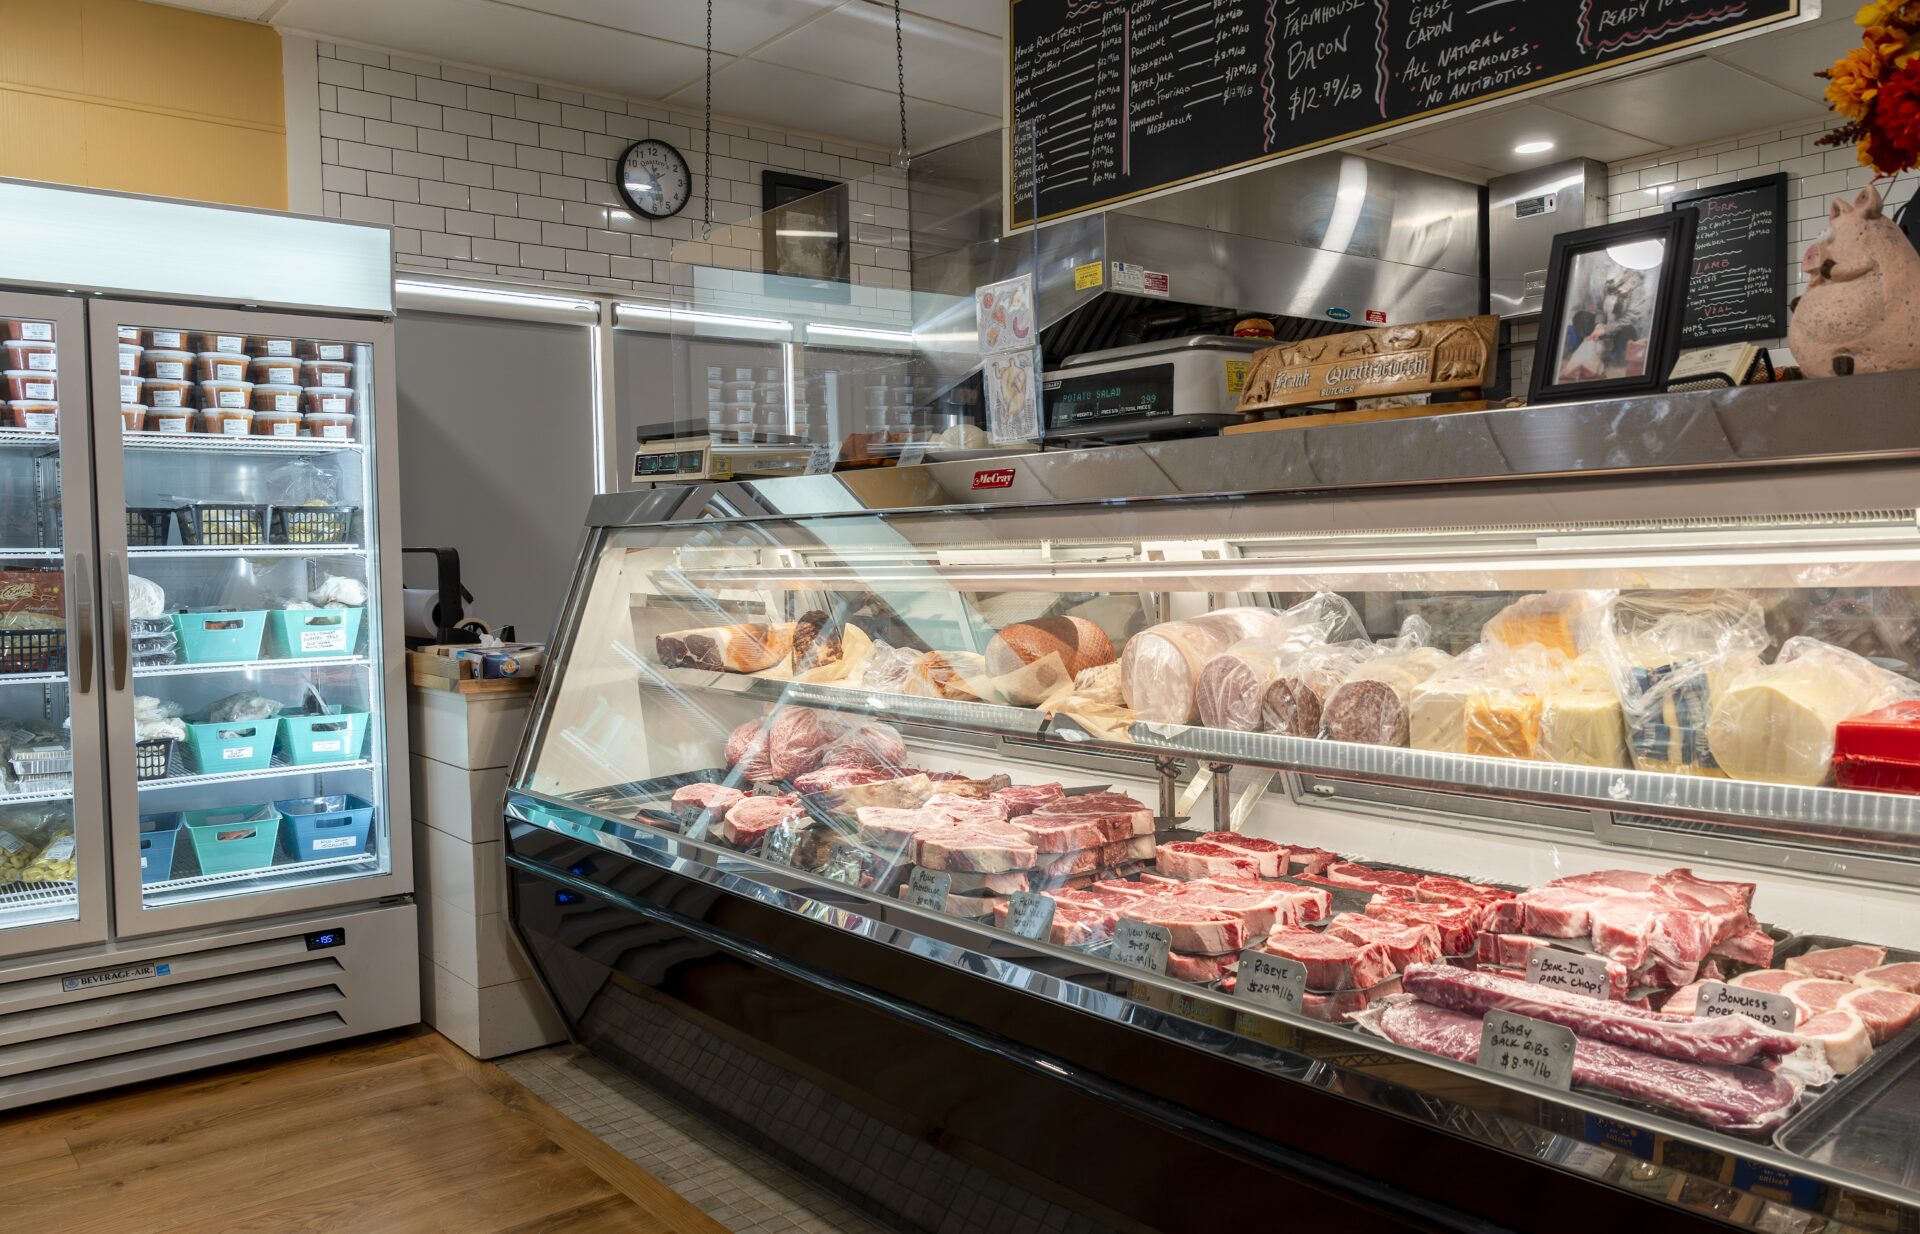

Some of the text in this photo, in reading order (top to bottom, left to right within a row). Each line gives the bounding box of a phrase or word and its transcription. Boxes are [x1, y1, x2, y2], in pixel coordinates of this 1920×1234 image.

[1405, 12, 1453, 50] CAPON
[1288, 25, 1351, 80] BACON
[1437, 30, 1505, 67] NATURAL
[1402, 56, 1430, 84] ALL
[1420, 43, 1529, 93] NO HORMONES
[1288, 74, 1363, 121] $12.99/LB
[1425, 62, 1532, 108] NO ANTIBIOTICS
[1096, 387, 1121, 399] SALAD
[1274, 369, 1310, 393] Frank
[1320, 385, 1356, 397] BUTCHER
[980, 473, 1012, 484] McCray
[1491, 1035, 1520, 1049] BACK
